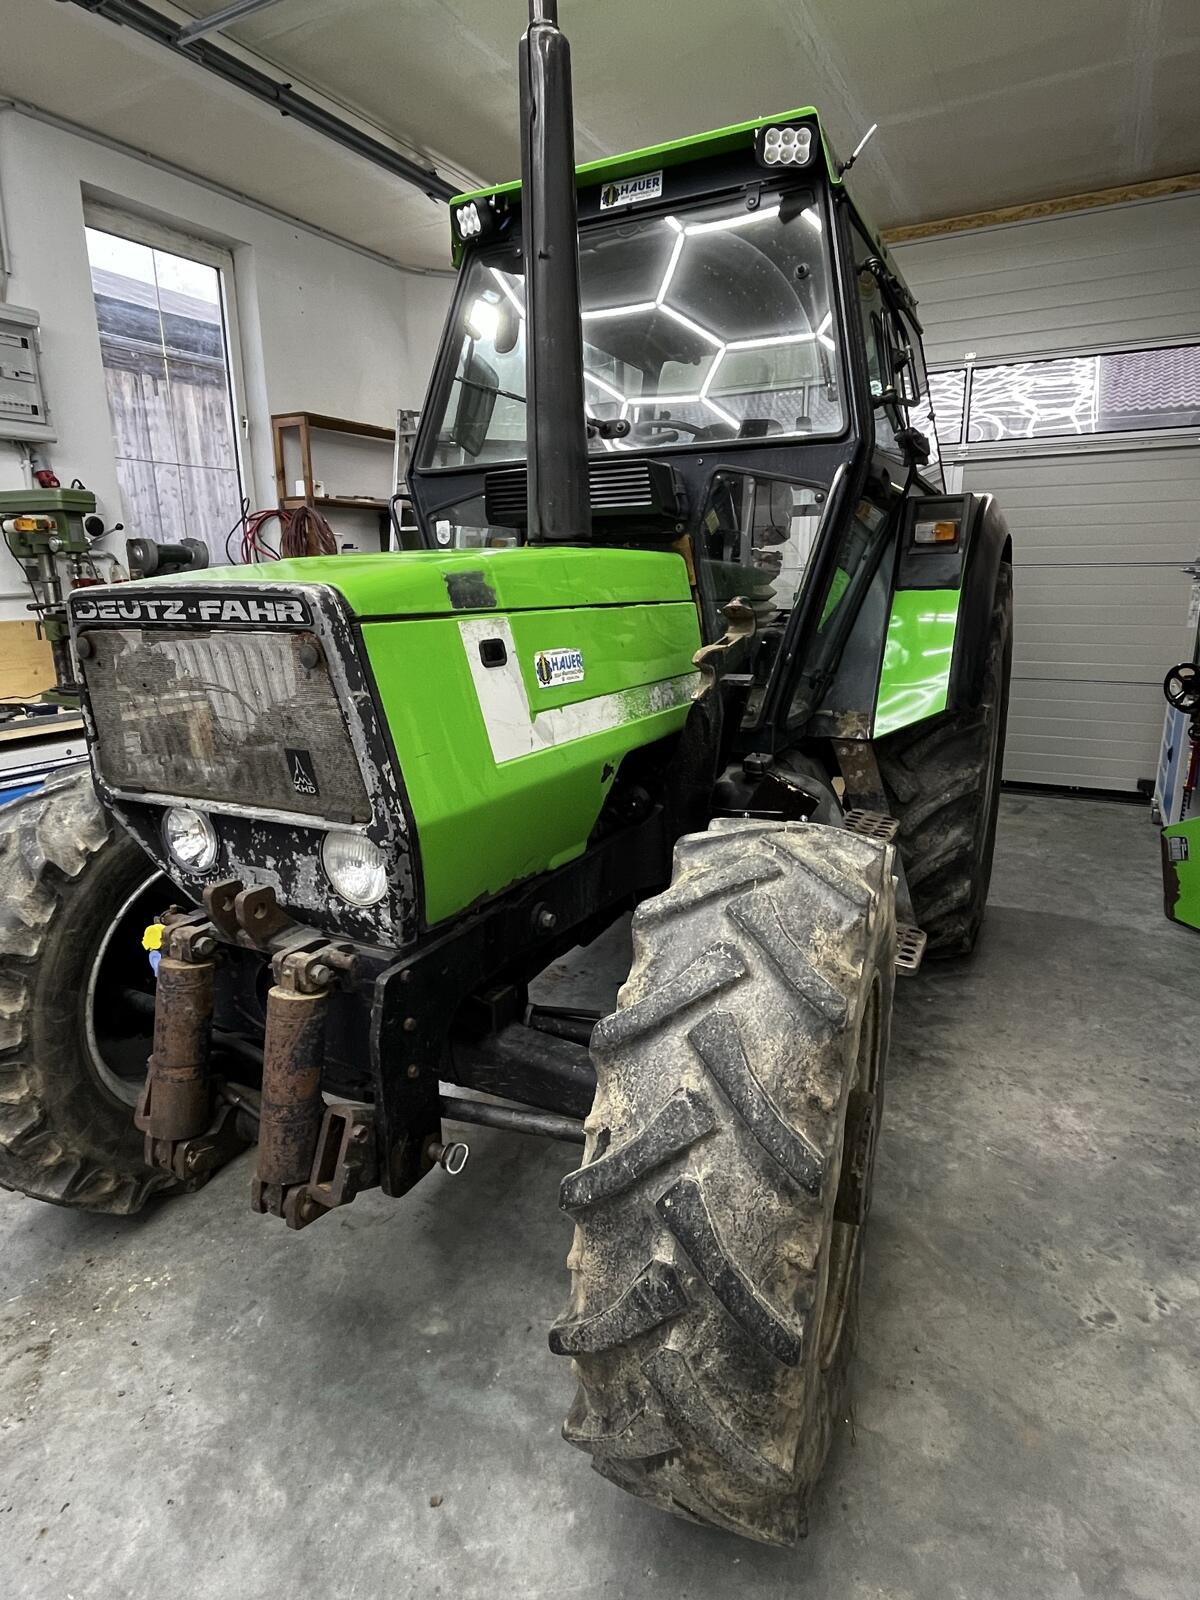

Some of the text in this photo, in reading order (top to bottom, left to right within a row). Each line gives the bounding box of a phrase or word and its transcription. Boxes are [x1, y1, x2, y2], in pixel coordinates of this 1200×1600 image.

[620, 177, 660, 195] HAUER
[551, 654, 583, 671] HAUER
[294, 784, 316, 794] KHD
